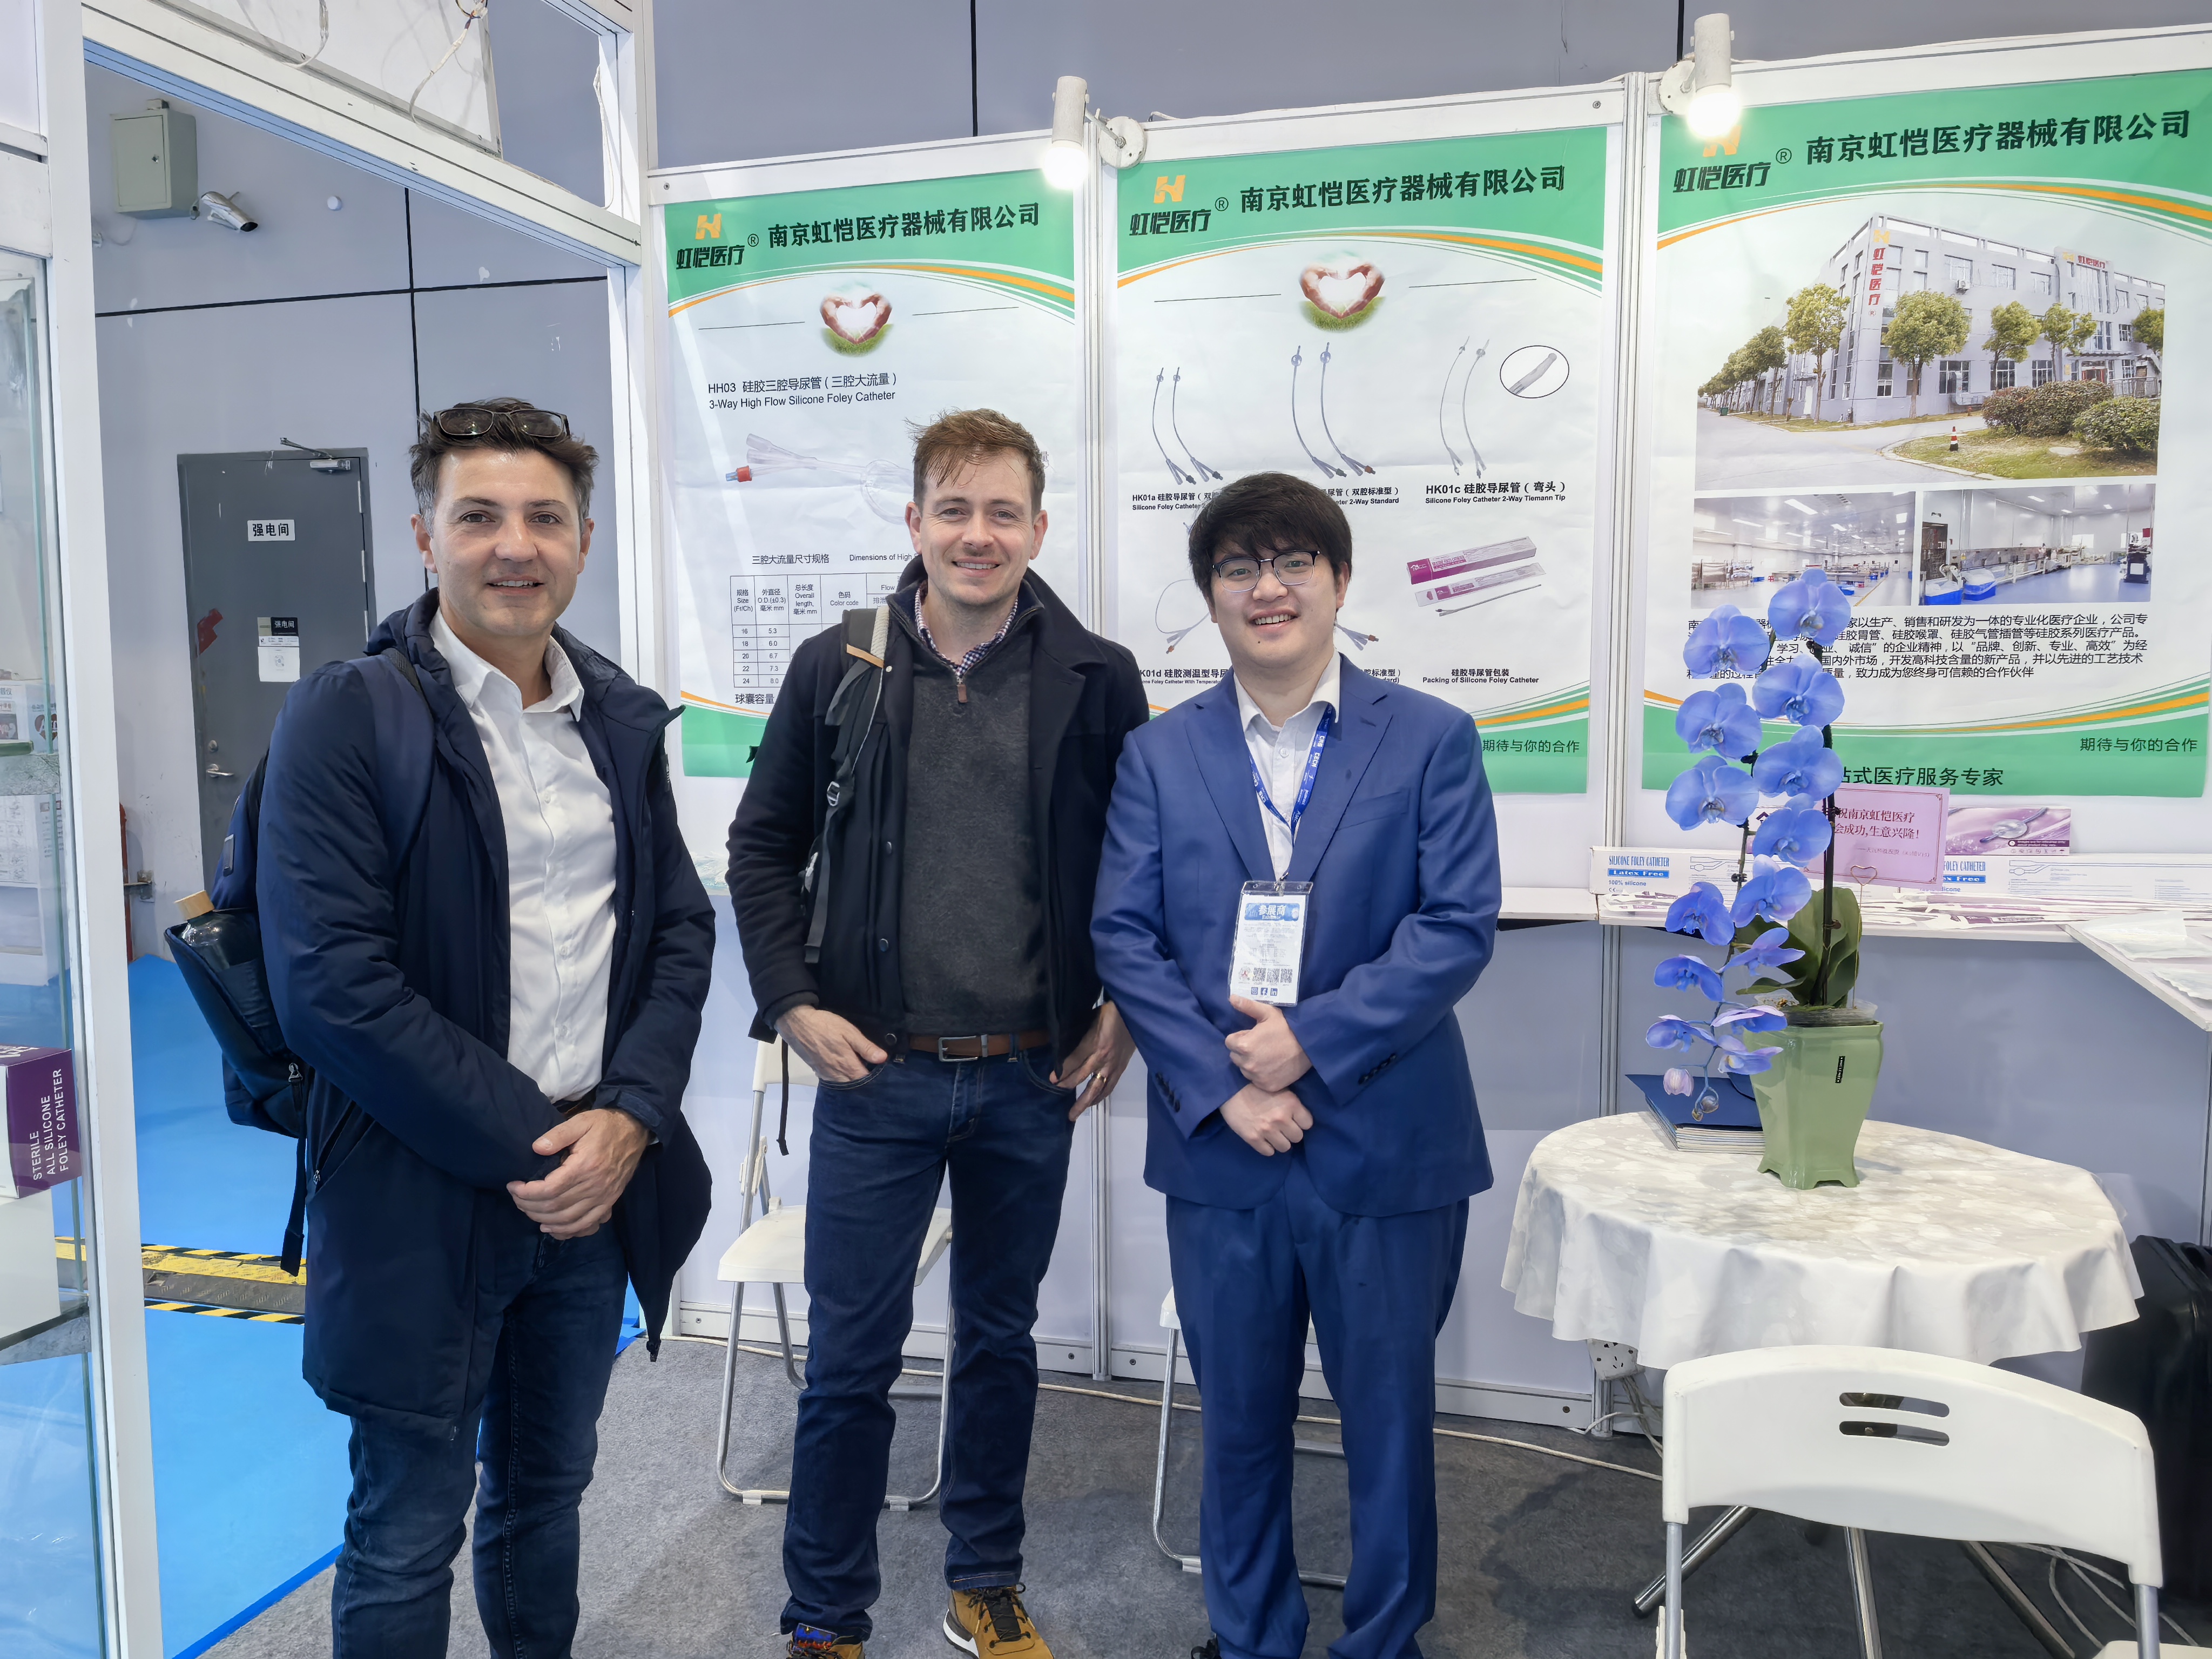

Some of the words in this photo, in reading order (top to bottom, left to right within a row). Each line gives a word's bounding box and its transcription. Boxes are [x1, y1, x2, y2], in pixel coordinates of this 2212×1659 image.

[1806, 110, 2191, 165] 南京虹恺医疗器械有限公司
[1673, 161, 1771, 193] 虹恺医疗
[1240, 166, 1566, 213] 南京虹恺医疗器械有限公司
[768, 203, 1040, 248] 南京虹恺医疗器械有限公司
[1129, 209, 1211, 236] 虹恺医疗
[676, 245, 745, 269] 虹恺医疗
[708, 383, 736, 394] HH03
[709, 399, 738, 410] 3-Way
[740, 397, 761, 410] High
[765, 396, 786, 407] Flow
[788, 394, 824, 406] Silicone
[827, 393, 853, 404] Foley
[855, 391, 896, 402] Catheter
[1323, 487, 1399, 497] 尿管（双腔标准型）
[1426, 485, 1461, 494] HK01c
[252, 523, 289, 536] 强电间
[752, 554, 830, 565] 三腔大流量尺寸规格
[897, 554, 912, 562] High
[1139, 669, 1162, 677] K01d
[1451, 669, 1509, 677] 硅胶导尿管包装
[1422, 677, 1450, 685] Packing
[735, 694, 775, 704] 球囊容量
[1482, 739, 1580, 753] 期待与你的合作
[2080, 737, 2198, 752] 期待与你的合作
[1609, 855, 1630, 865] SILICONE
[1631, 856, 1644, 866] FOLEY
[1646, 857, 1669, 867] CATHETER
[1960, 861, 1986, 871] CATHETER
[53, 1068, 65, 1130] CATHETER
[41, 1095, 54, 1150] SILICONE
[30, 1131, 42, 1181] STERILE
[58, 1135, 69, 1172] FOLEY
[46, 1153, 55, 1175] ALL
